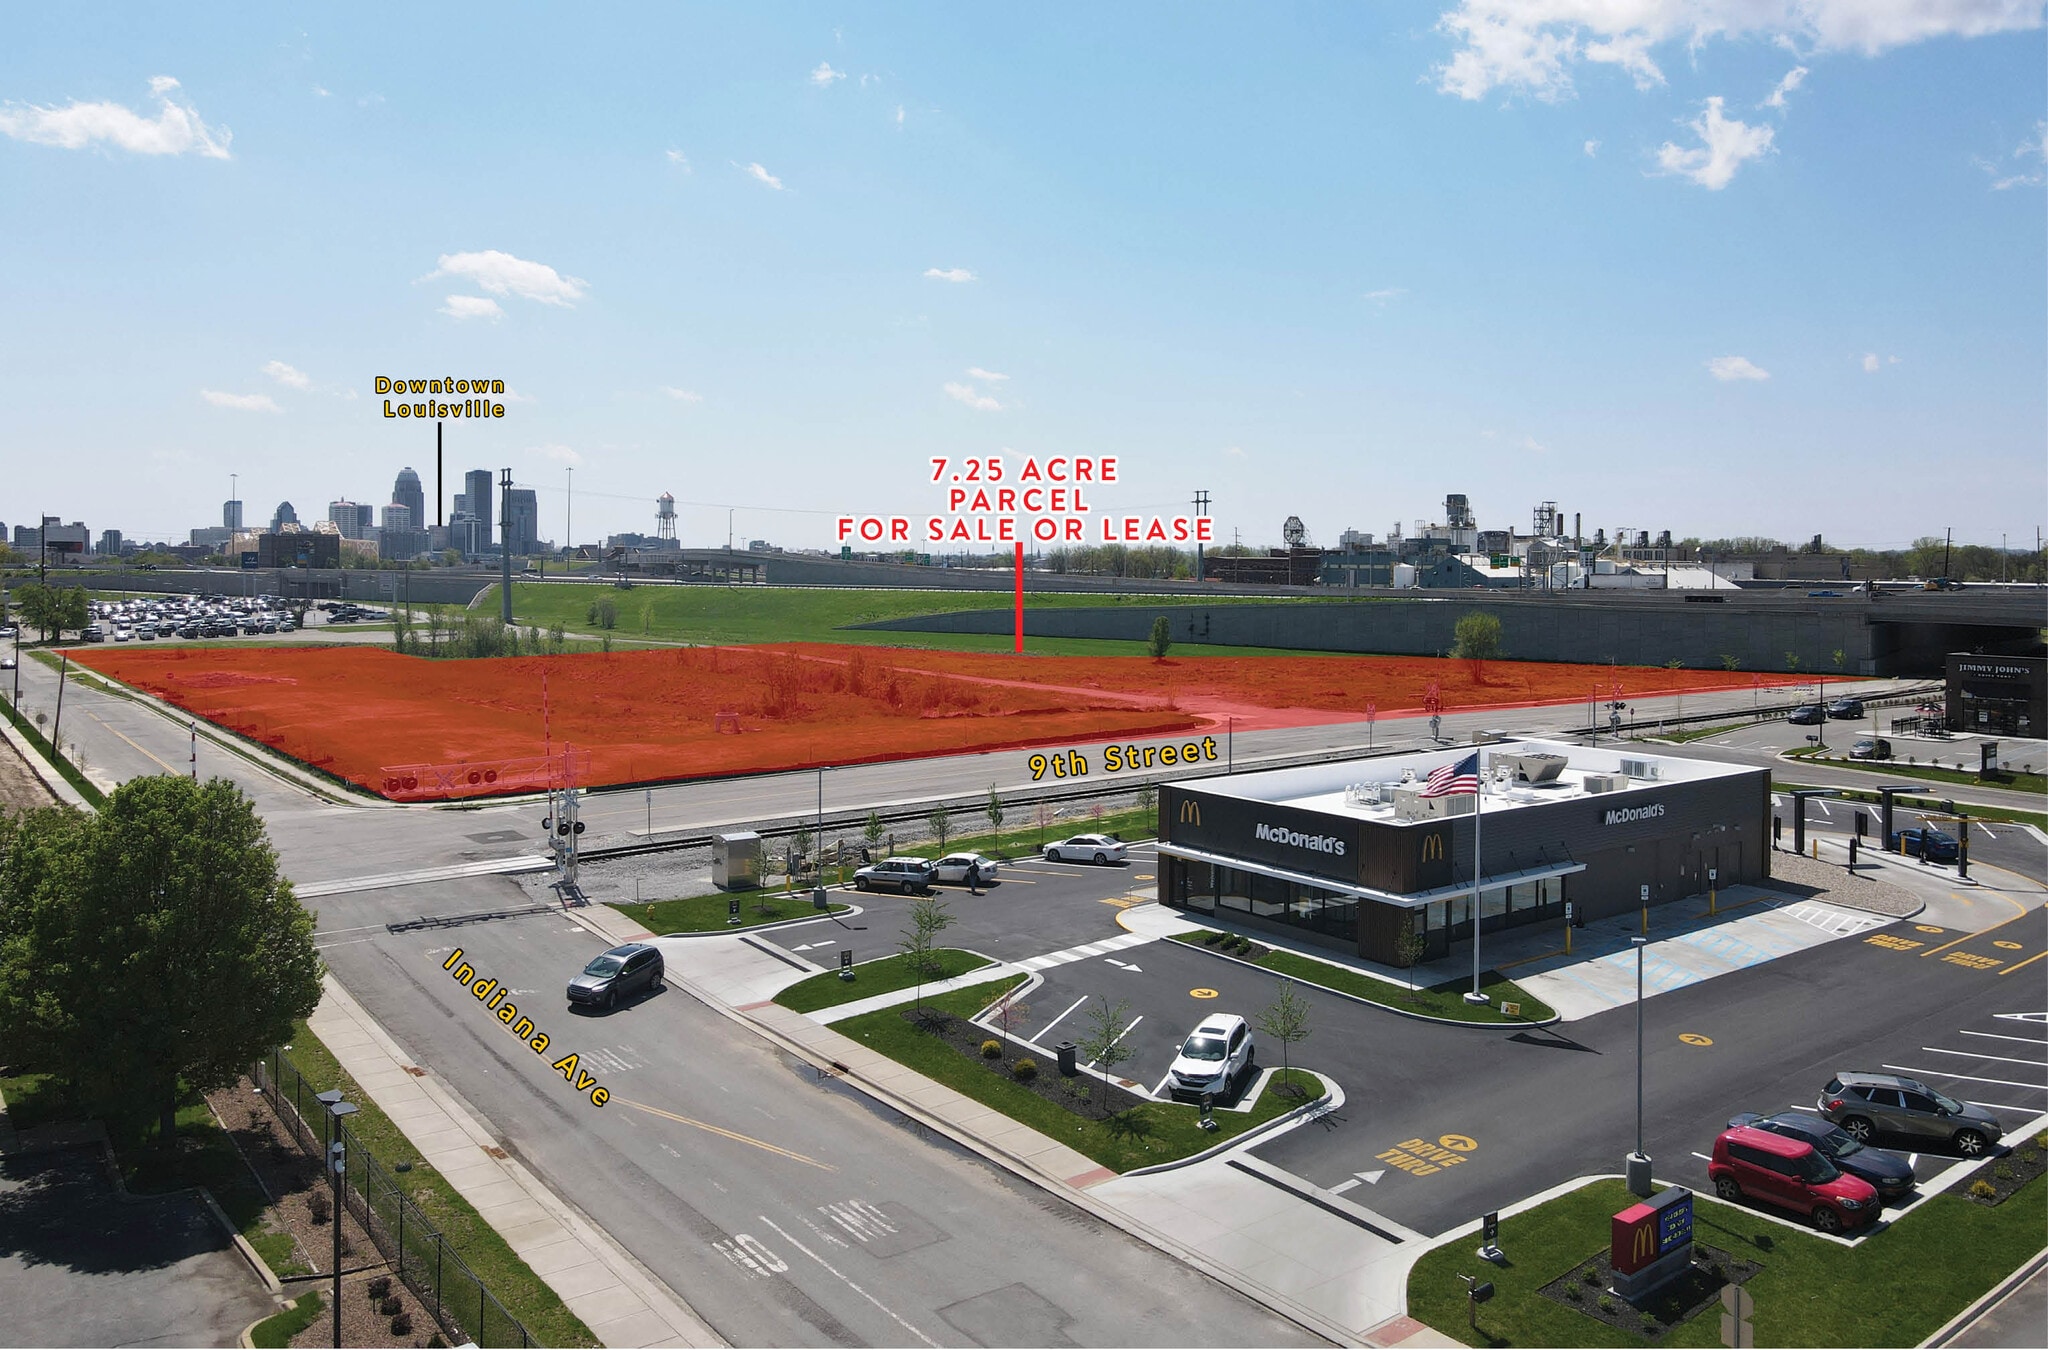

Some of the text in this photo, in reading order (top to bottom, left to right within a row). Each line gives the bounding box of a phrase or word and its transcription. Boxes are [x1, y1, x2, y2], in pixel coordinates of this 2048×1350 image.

[1959, 663, 2031, 675] JIMMY JOHN'S
[1604, 802, 1666, 826] McDonald's
[1255, 823, 1345, 856] McDonald's
[1375, 1148, 1442, 1177] THRU
[1396, 1138, 1468, 1168] DRIVE
